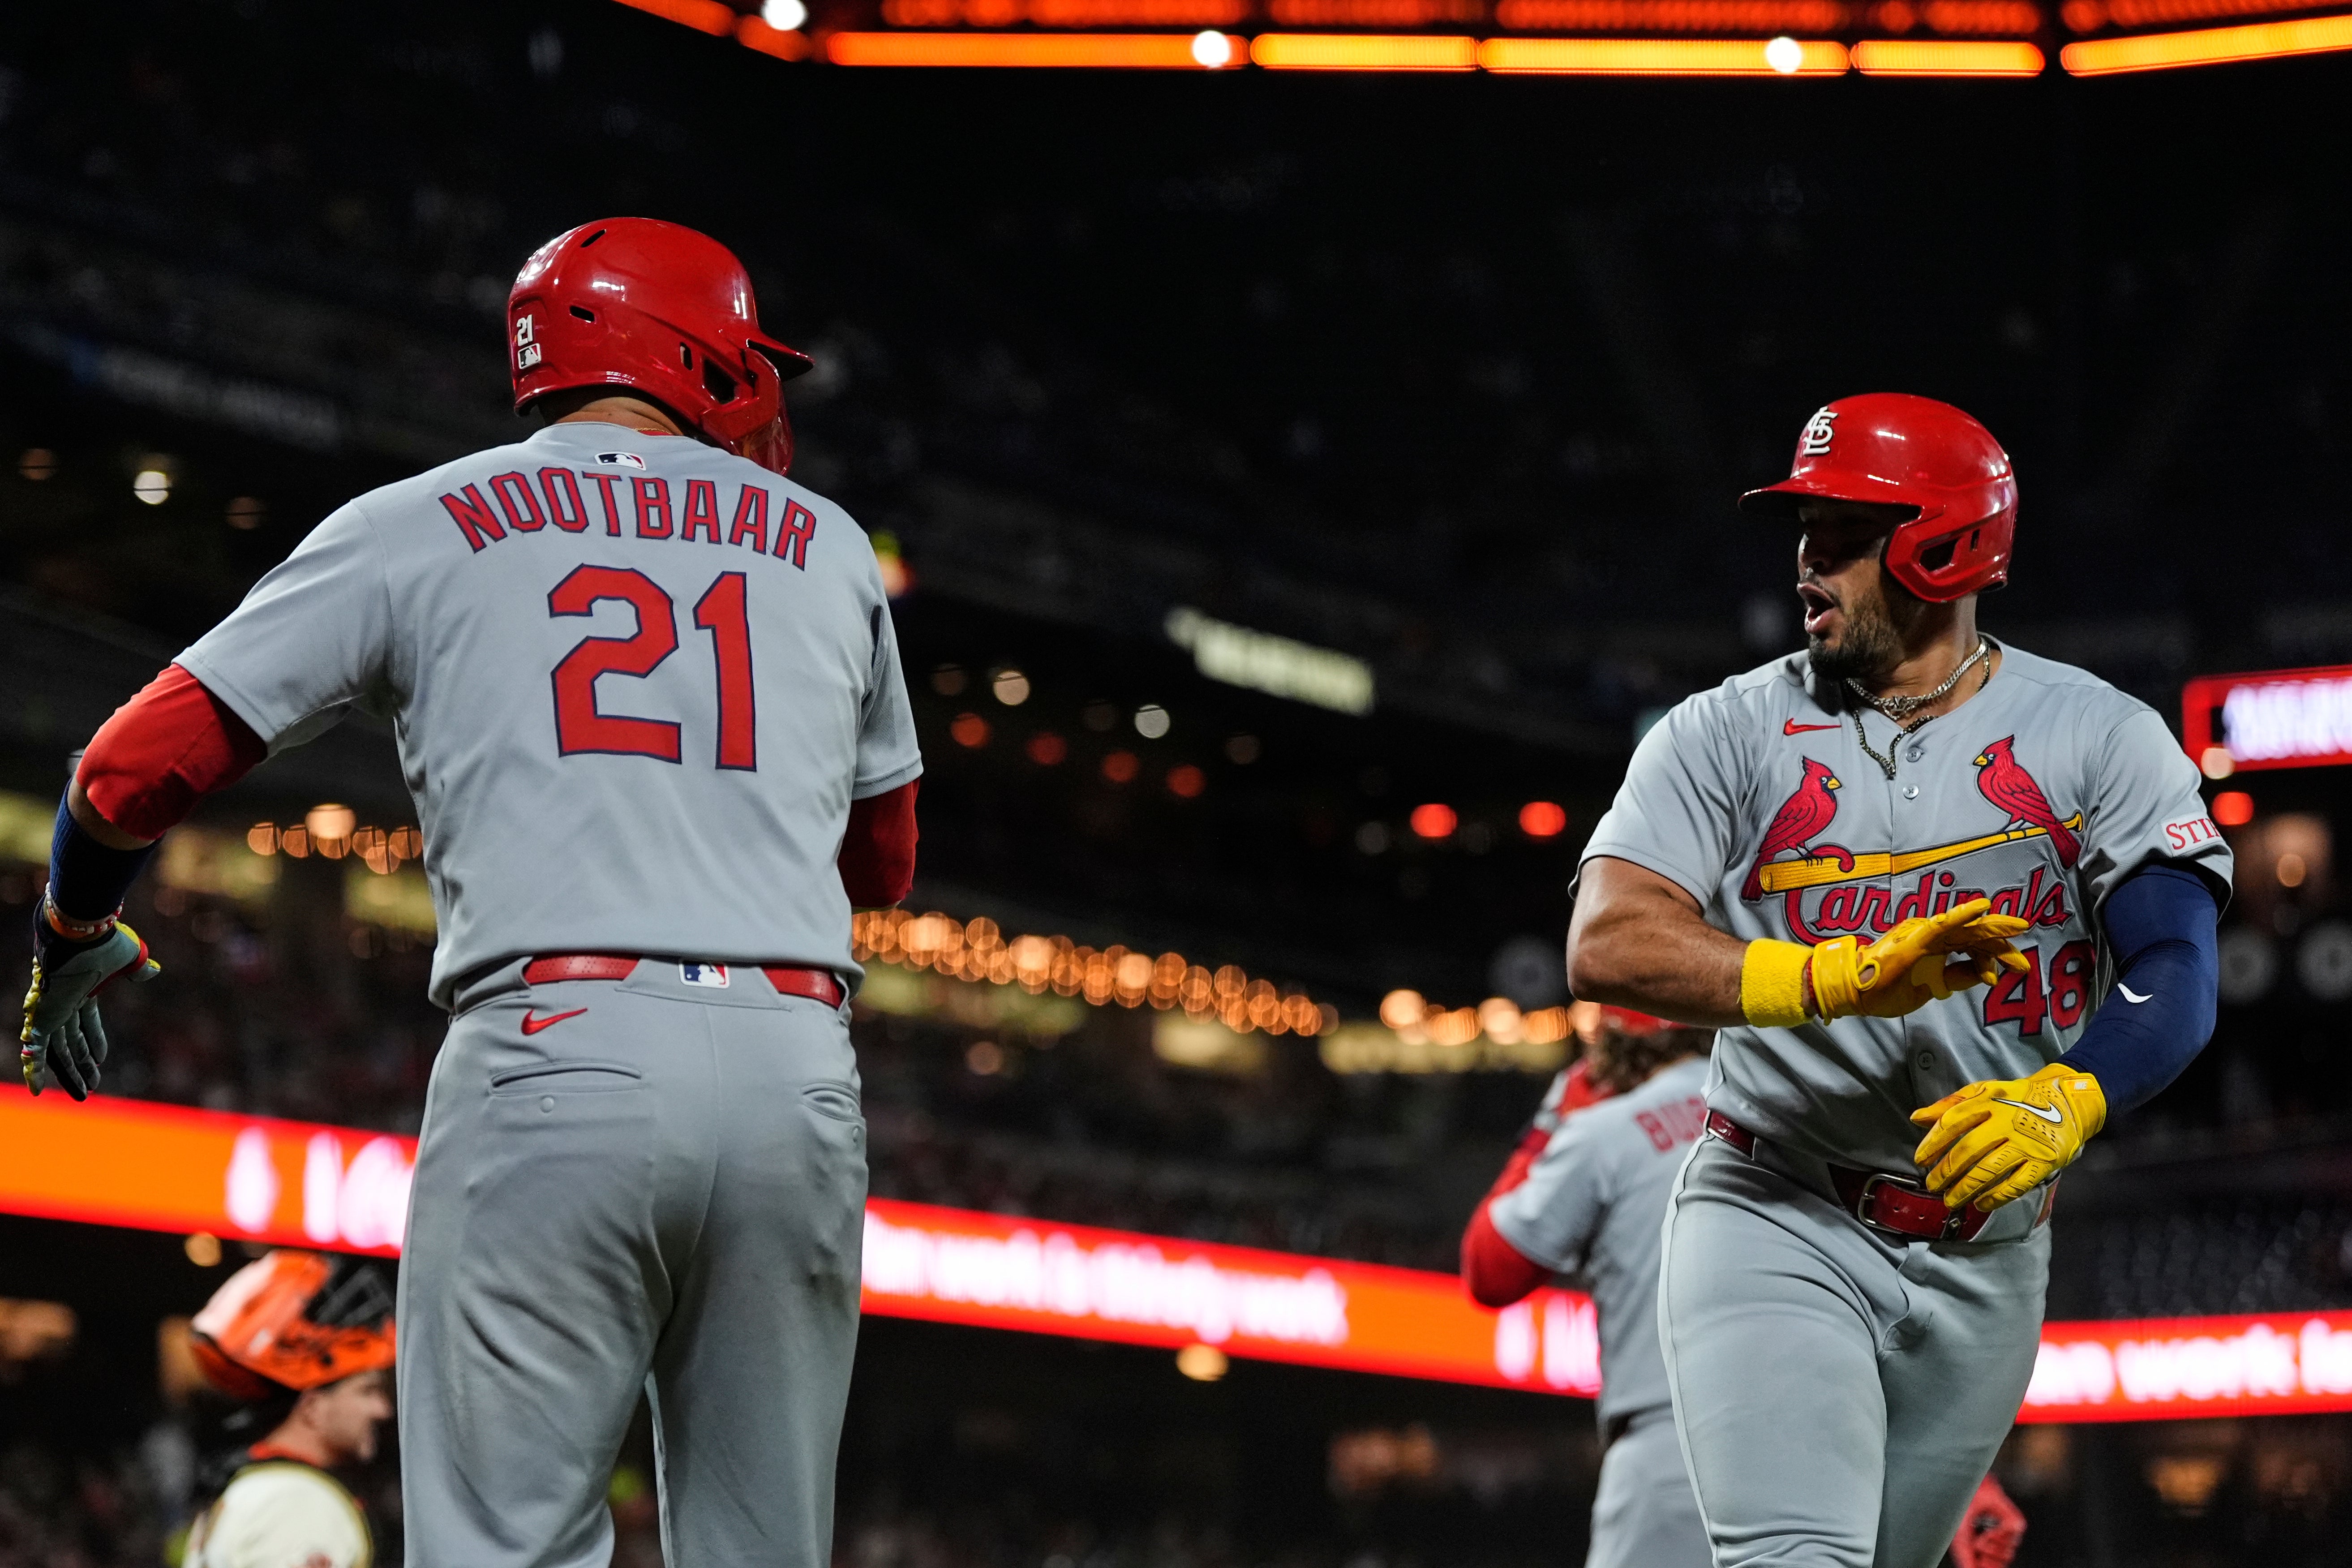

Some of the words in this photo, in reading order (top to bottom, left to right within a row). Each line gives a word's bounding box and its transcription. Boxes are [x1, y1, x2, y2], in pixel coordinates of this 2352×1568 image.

[516, 314, 533, 347] 21
[438, 467, 816, 571] NOOTBAAR
[547, 563, 757, 772] 21
[1983, 939, 2096, 1038] 48
[2074, 1081, 2087, 1090] NIKE
